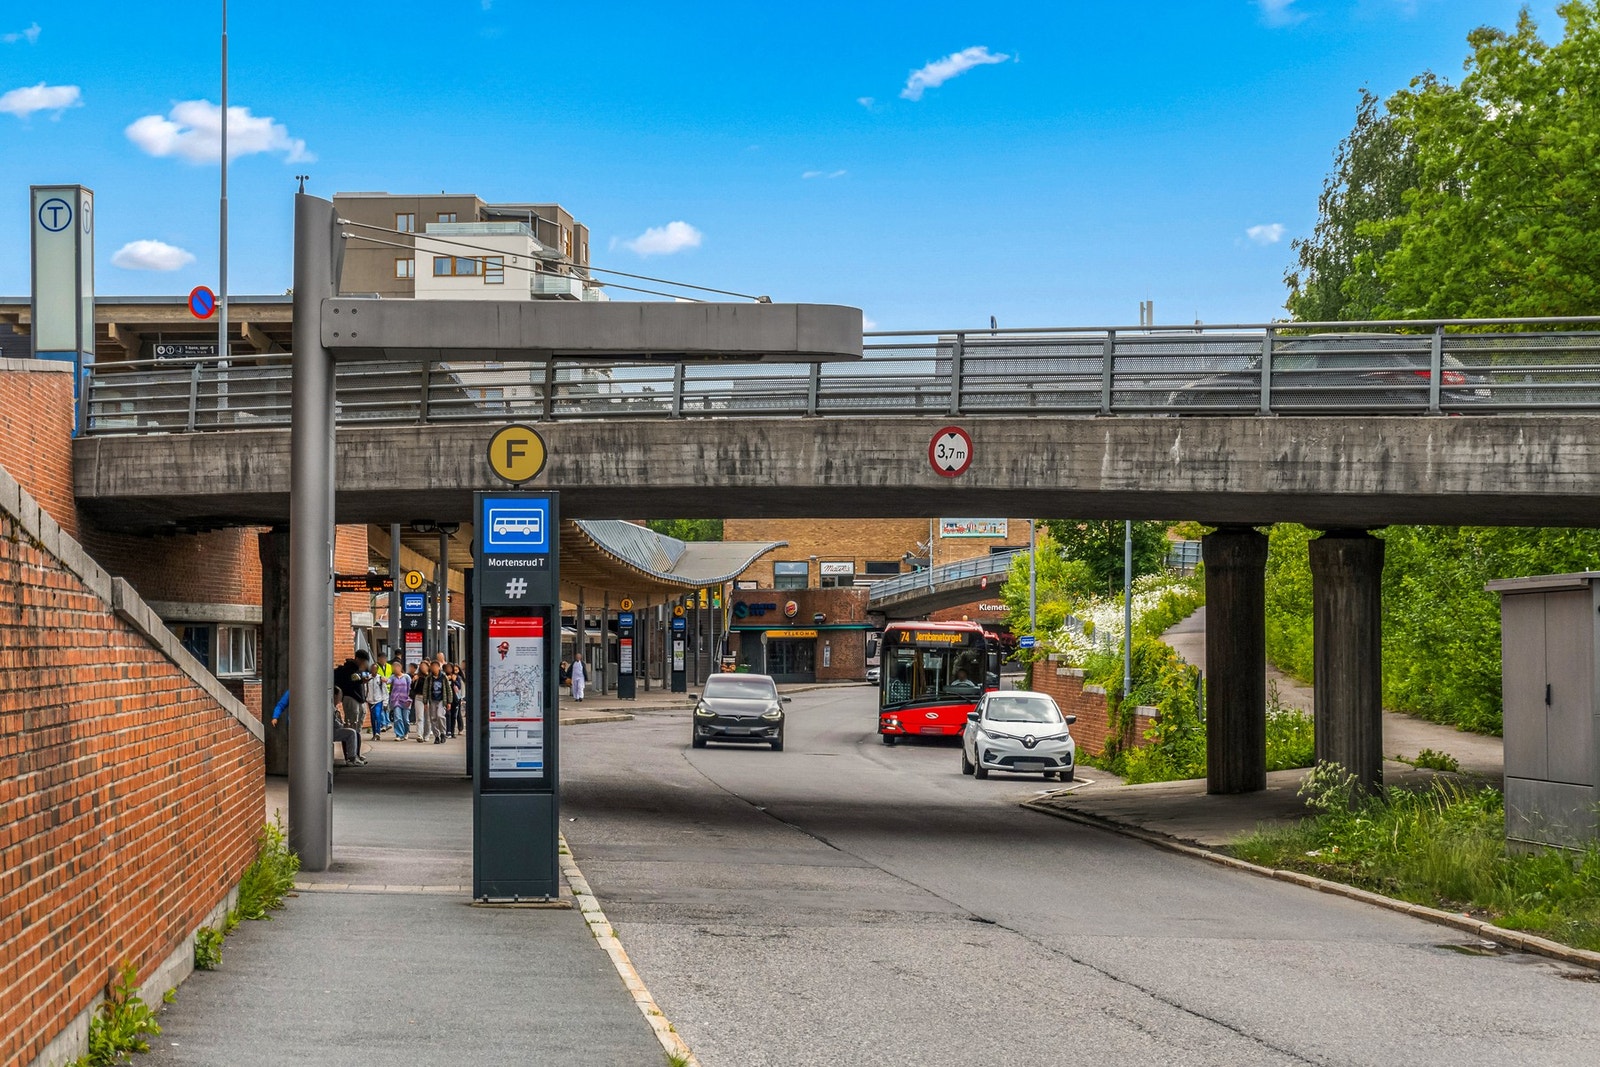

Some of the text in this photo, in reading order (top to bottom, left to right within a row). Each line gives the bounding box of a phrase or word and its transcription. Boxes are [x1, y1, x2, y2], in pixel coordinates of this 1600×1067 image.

[47, 206, 64, 228] T
[506, 439, 528, 468] F
[937, 443, 965, 461] 3,7 m
[488, 558, 545, 567] Mortensrud T
[410, 575, 418, 585] D
[900, 631, 962, 644] 74 Jernbanetorget
